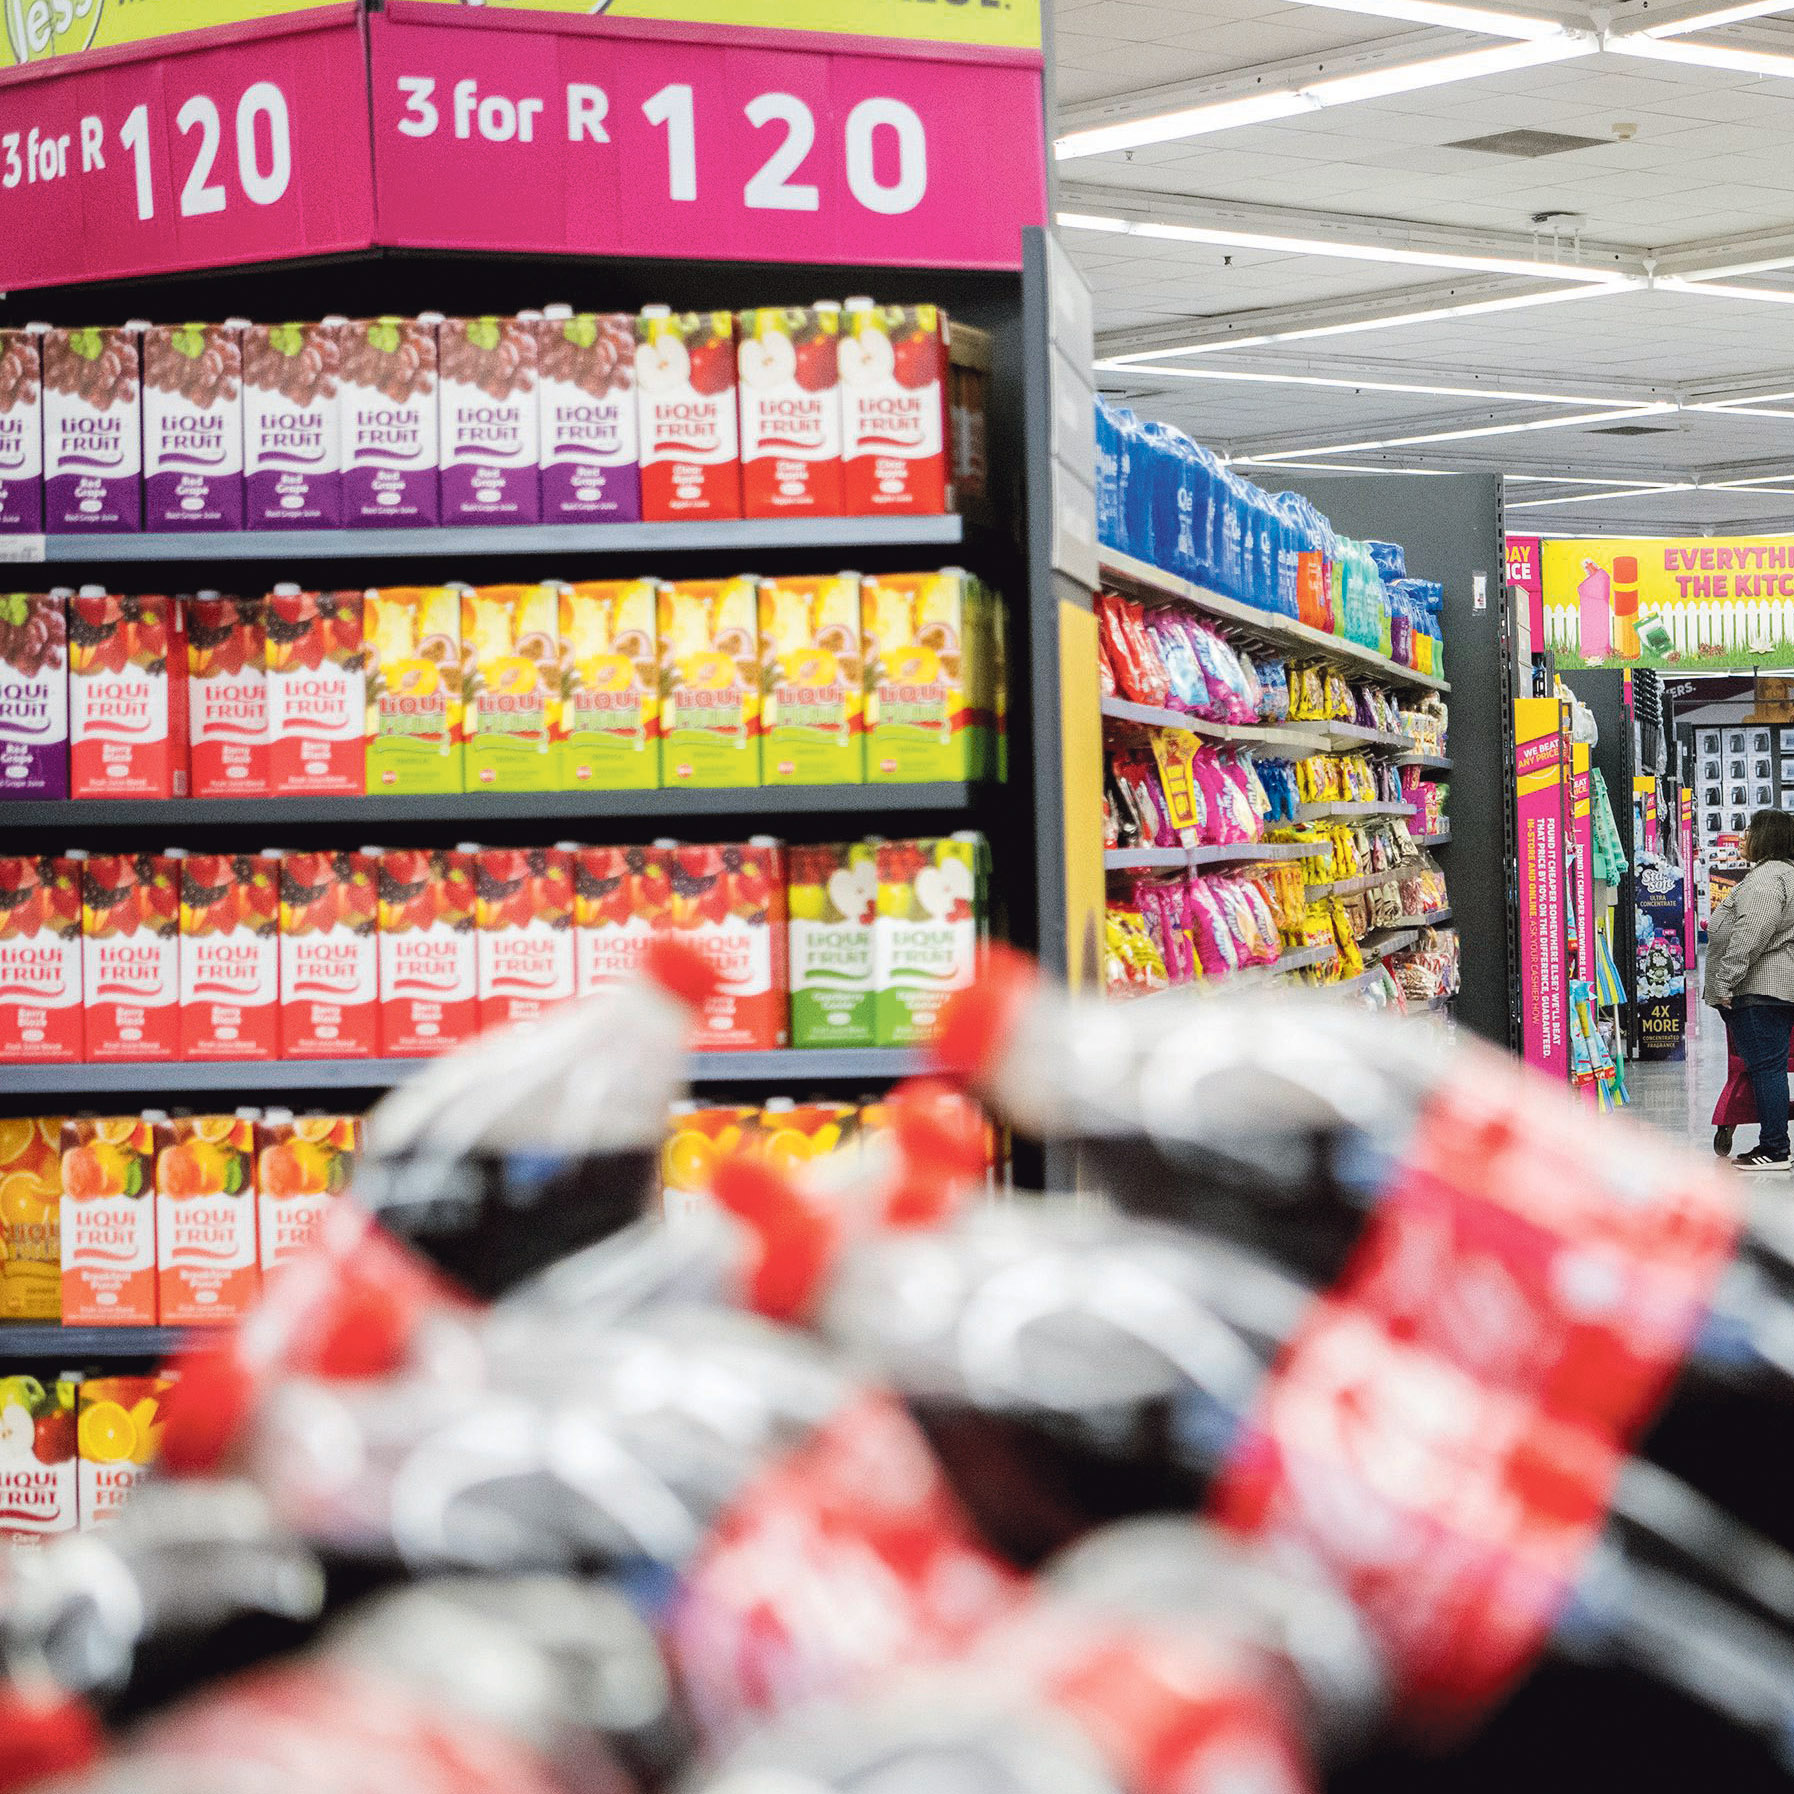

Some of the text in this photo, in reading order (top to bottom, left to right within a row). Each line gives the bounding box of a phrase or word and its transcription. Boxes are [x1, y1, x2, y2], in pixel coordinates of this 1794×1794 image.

[397, 76, 440, 138] 3
[453, 79, 545, 142] for
[2, 132, 22, 189] 3
[28, 125, 71, 184] for
[1675, 574, 1728, 598] THE
[1523, 739, 1559, 758] WE BEAT
[1518, 749, 1559, 769] ANY PRICE
[1527, 818, 1536, 860] IN-STORE
[1537, 818, 1545, 841] THAT
[1538, 843, 1546, 869] PRICE
[1528, 862, 1536, 881] AND
[1538, 870, 1546, 882] BY
[1539, 884, 1547, 902] 10%
[1539, 903, 1547, 917] ON
[1530, 921, 1538, 938] ASK
[1539, 918, 1547, 936] THE
[1547, 818, 1560, 1045] FOUND IT CHEAPER SOMEWHERE ELSE? WE'LL BEAT
[1530, 940, 1538, 962] YOUR
[1531, 964, 1539, 1001] CASHIER
[1651, 1005, 1671, 1018] 4X
[1642, 1019, 1680, 1032] MORE
